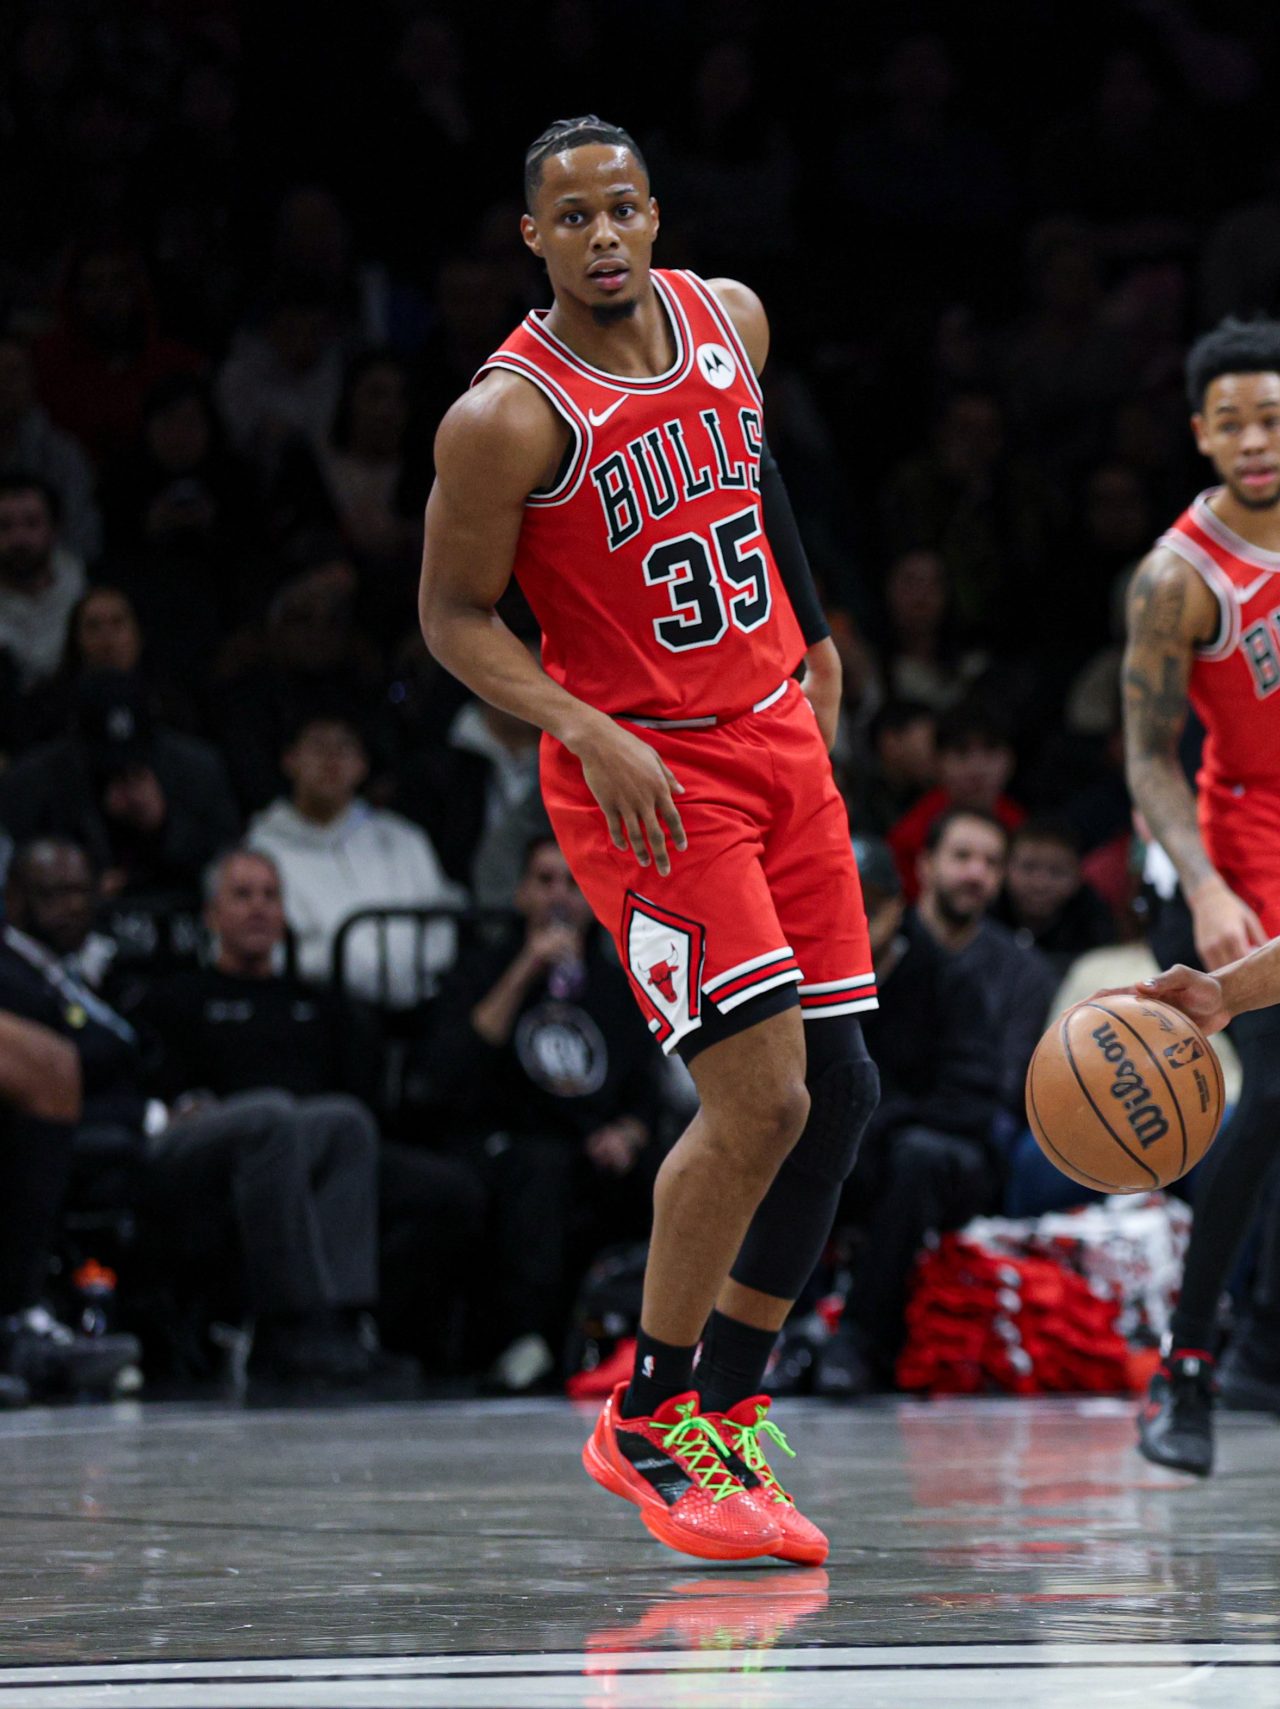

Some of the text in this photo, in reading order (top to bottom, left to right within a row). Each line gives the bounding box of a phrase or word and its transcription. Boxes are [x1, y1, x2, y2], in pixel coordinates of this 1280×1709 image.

[590, 407, 763, 552] BULLS
[641, 504, 771, 653] 35
[1091, 1021, 1171, 1150] Wilson
